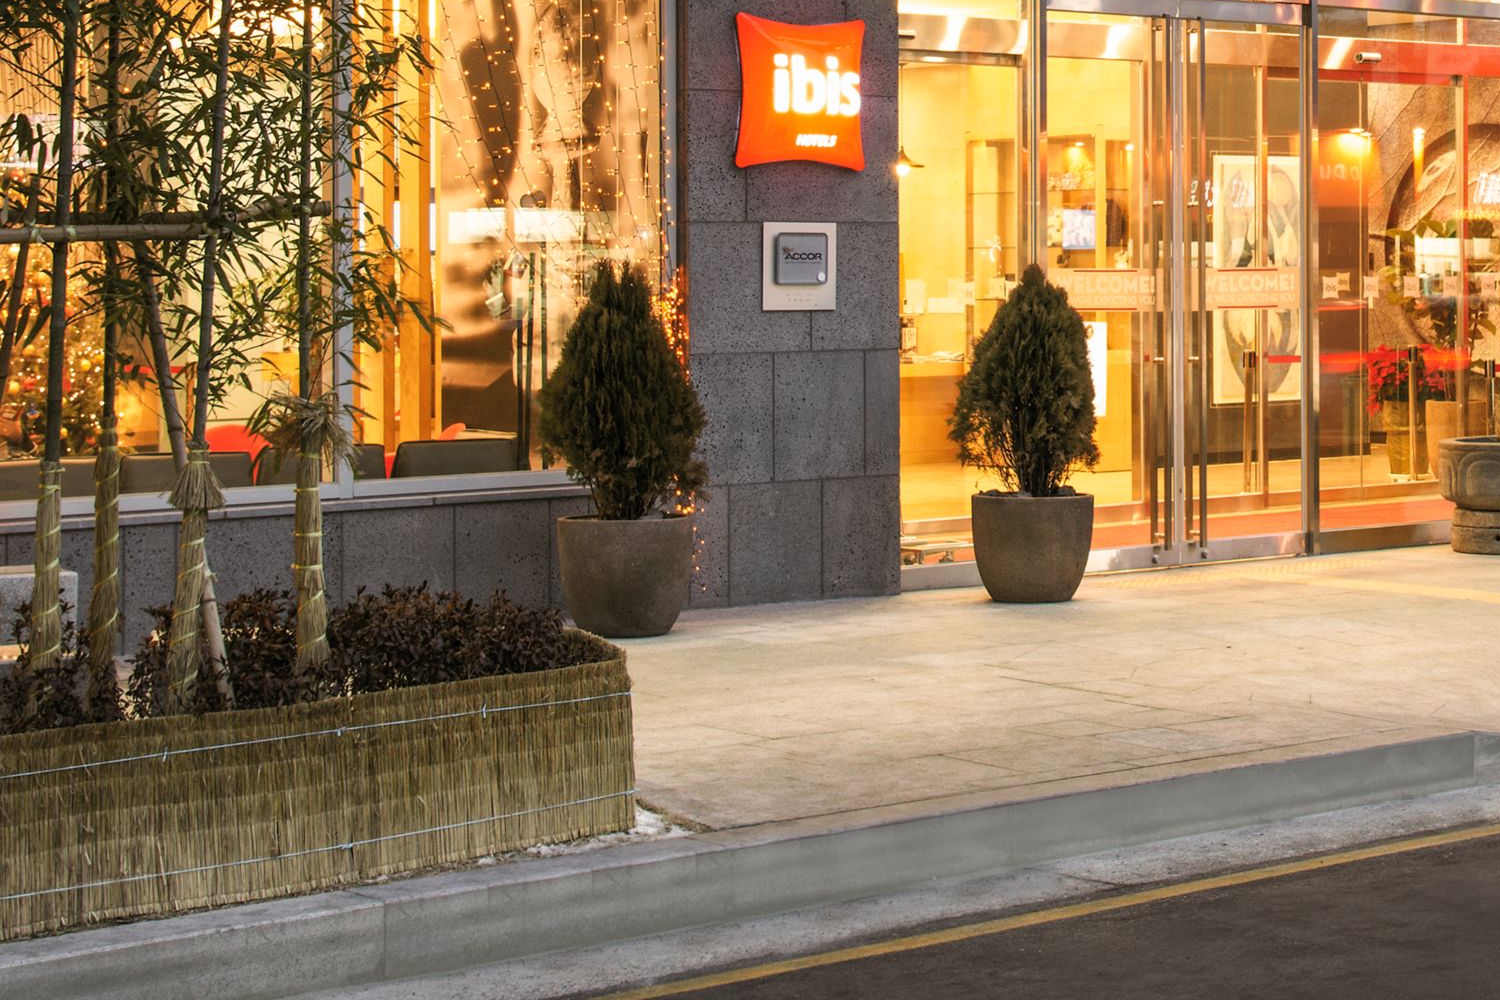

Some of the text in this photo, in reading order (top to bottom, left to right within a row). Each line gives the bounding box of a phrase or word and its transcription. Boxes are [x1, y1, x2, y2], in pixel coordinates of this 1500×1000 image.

[773, 53, 862, 118] ibis
[784, 252, 823, 261] ACCOR
[1056, 275, 1155, 294] WELCOME!
